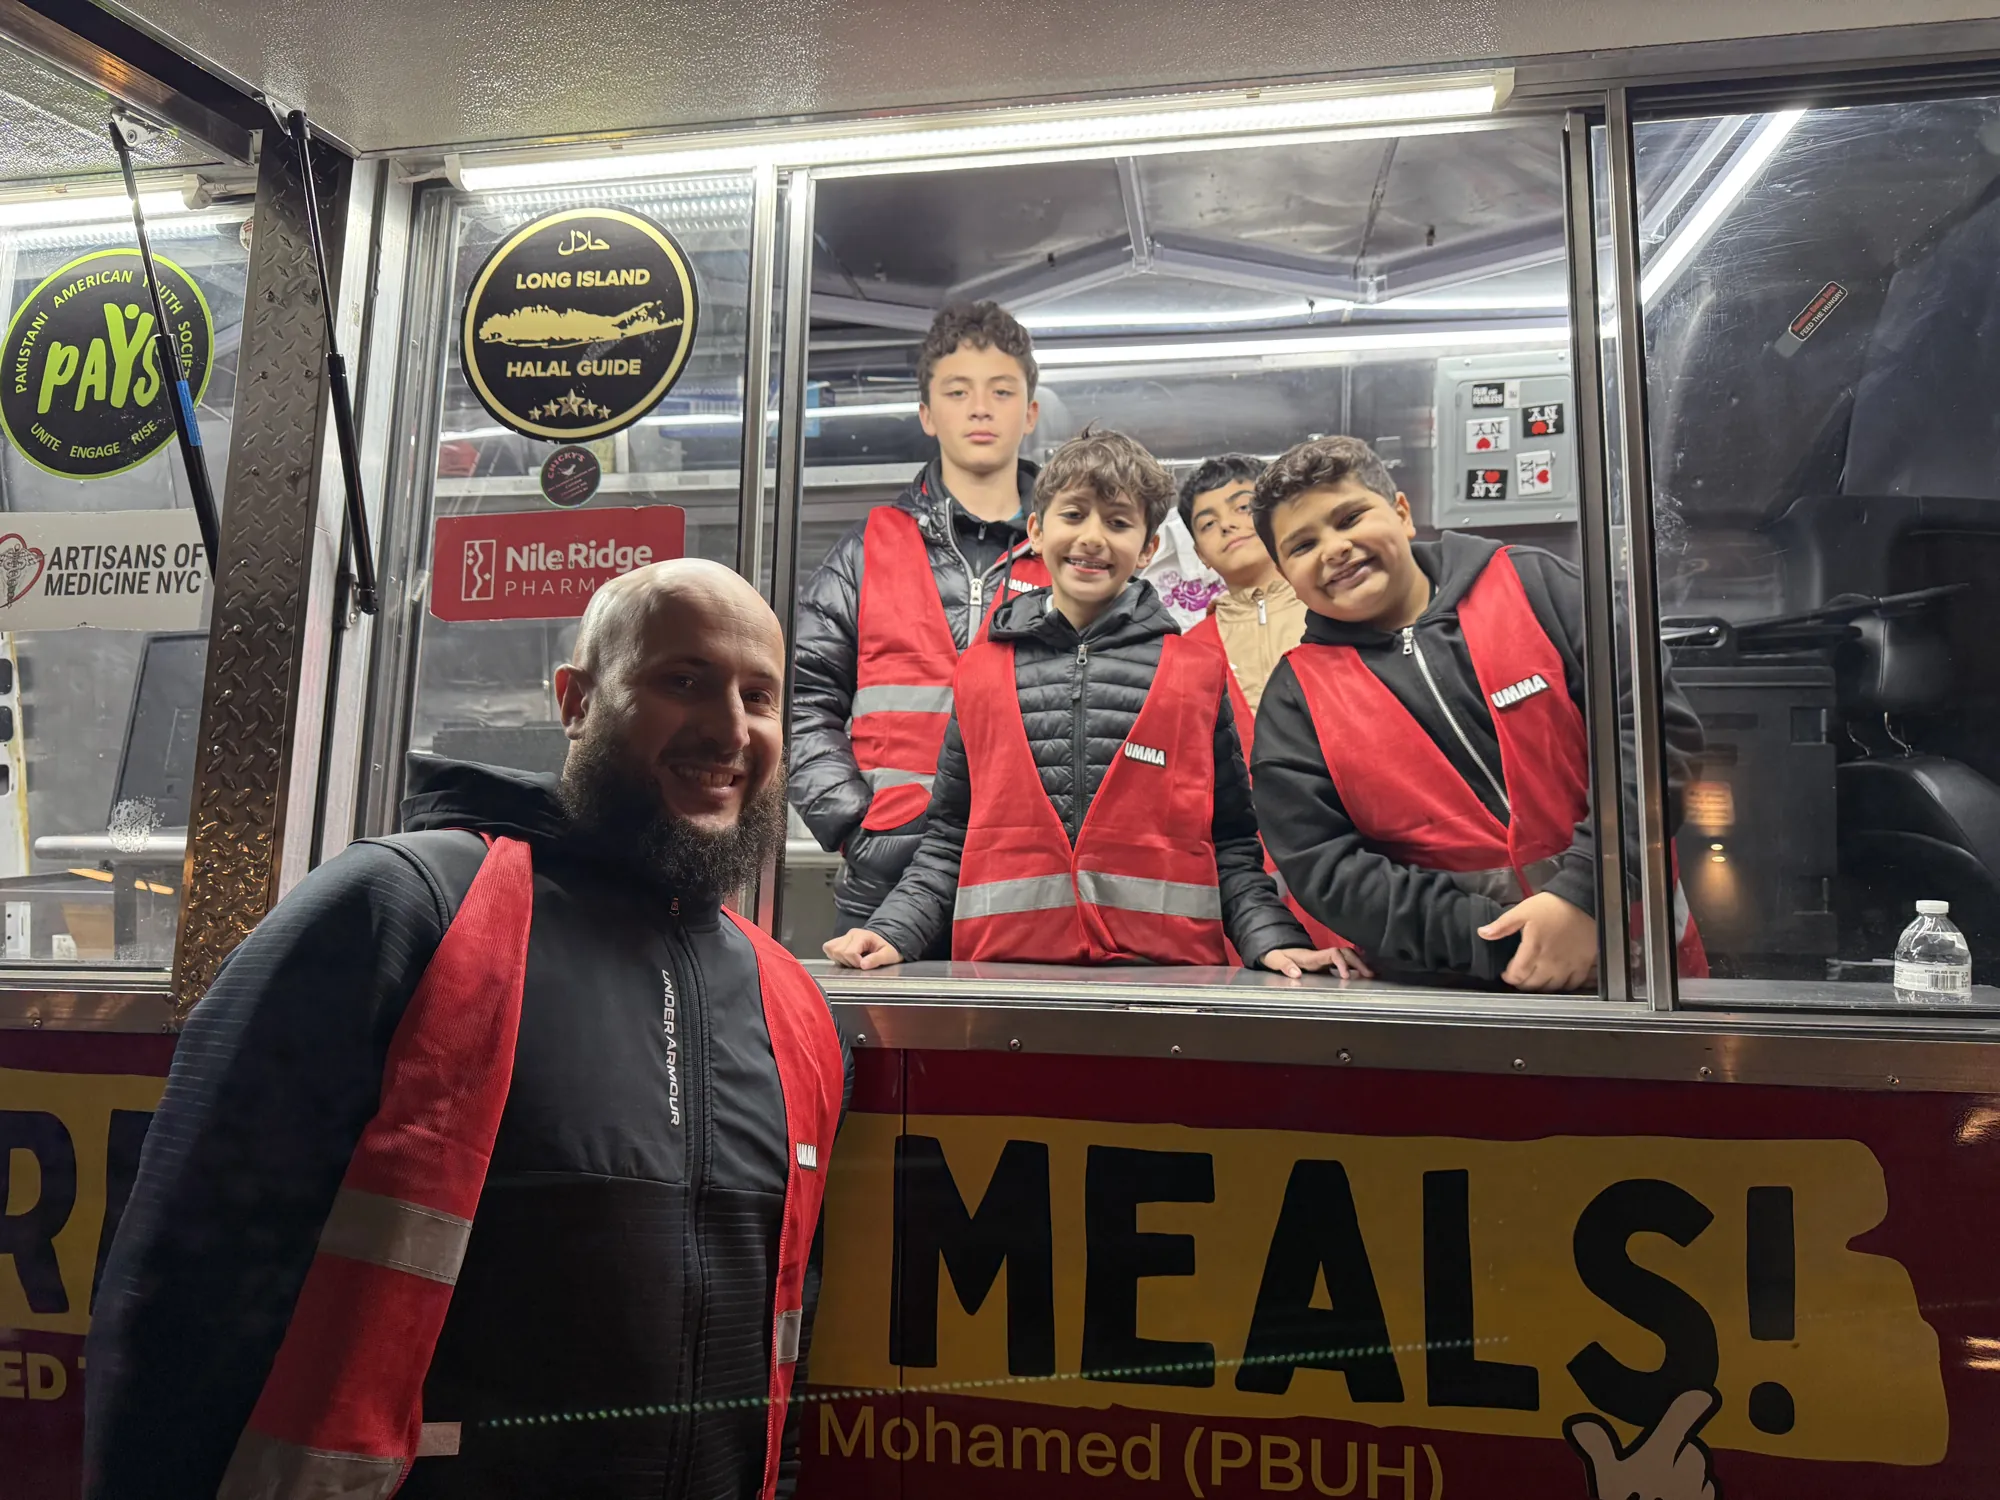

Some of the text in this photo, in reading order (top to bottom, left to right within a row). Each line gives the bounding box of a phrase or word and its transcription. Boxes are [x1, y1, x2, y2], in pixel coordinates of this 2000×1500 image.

[557, 230, 610, 256] حلال
[516, 269, 651, 289] LONG ISLAND
[1800, 289, 1844, 337] FEED THE HUNGRY
[16, 311, 49, 394] PAKISTANI
[53, 270, 133, 308] AMERICAN
[178, 320, 194, 379] SOCIET
[506, 359, 641, 378] HALAL GUIDE
[31, 421, 158, 459] UNITE ENGAGE RISE
[1471, 483, 1502, 497] NY
[47, 543, 205, 571] ARTISANS OF
[505, 539, 653, 574] Nile Ridge
[44, 570, 201, 596] MEDICINE NYC
[1003, 577, 1039, 593] UMM
[1490, 674, 1549, 708] UMMA
[1124, 742, 1166, 766] UMMA
[662, 969, 680, 1126] UNDER ARMOUR
[889, 1134, 1795, 1434] MEALS!
[818, 1403, 1443, 1500] Mohamed (PBUH)
